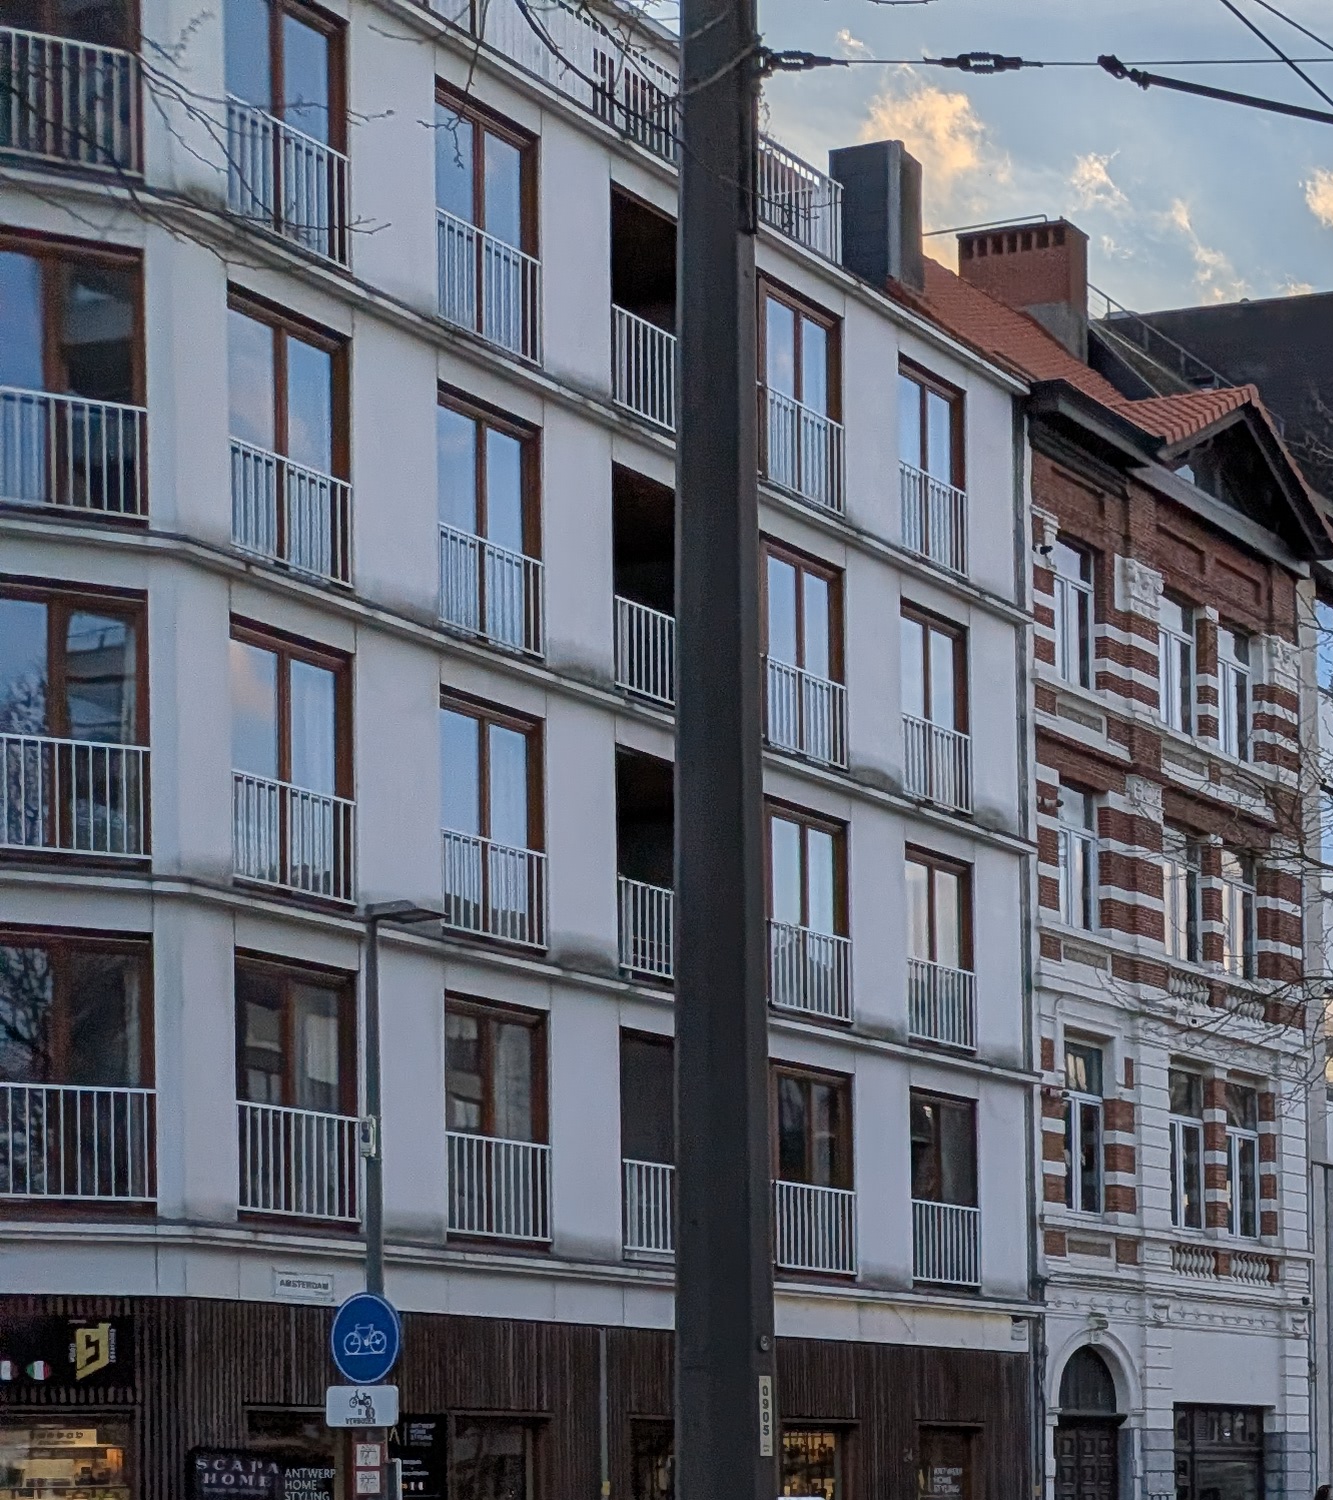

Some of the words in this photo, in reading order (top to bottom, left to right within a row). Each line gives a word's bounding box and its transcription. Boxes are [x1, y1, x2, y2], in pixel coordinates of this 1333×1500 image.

[195, 1459, 280, 1474] SCAPA
[284, 1467, 336, 1479] ANTWERP
[203, 1472, 272, 1487] HOME
[284, 1479, 317, 1491] HOME
